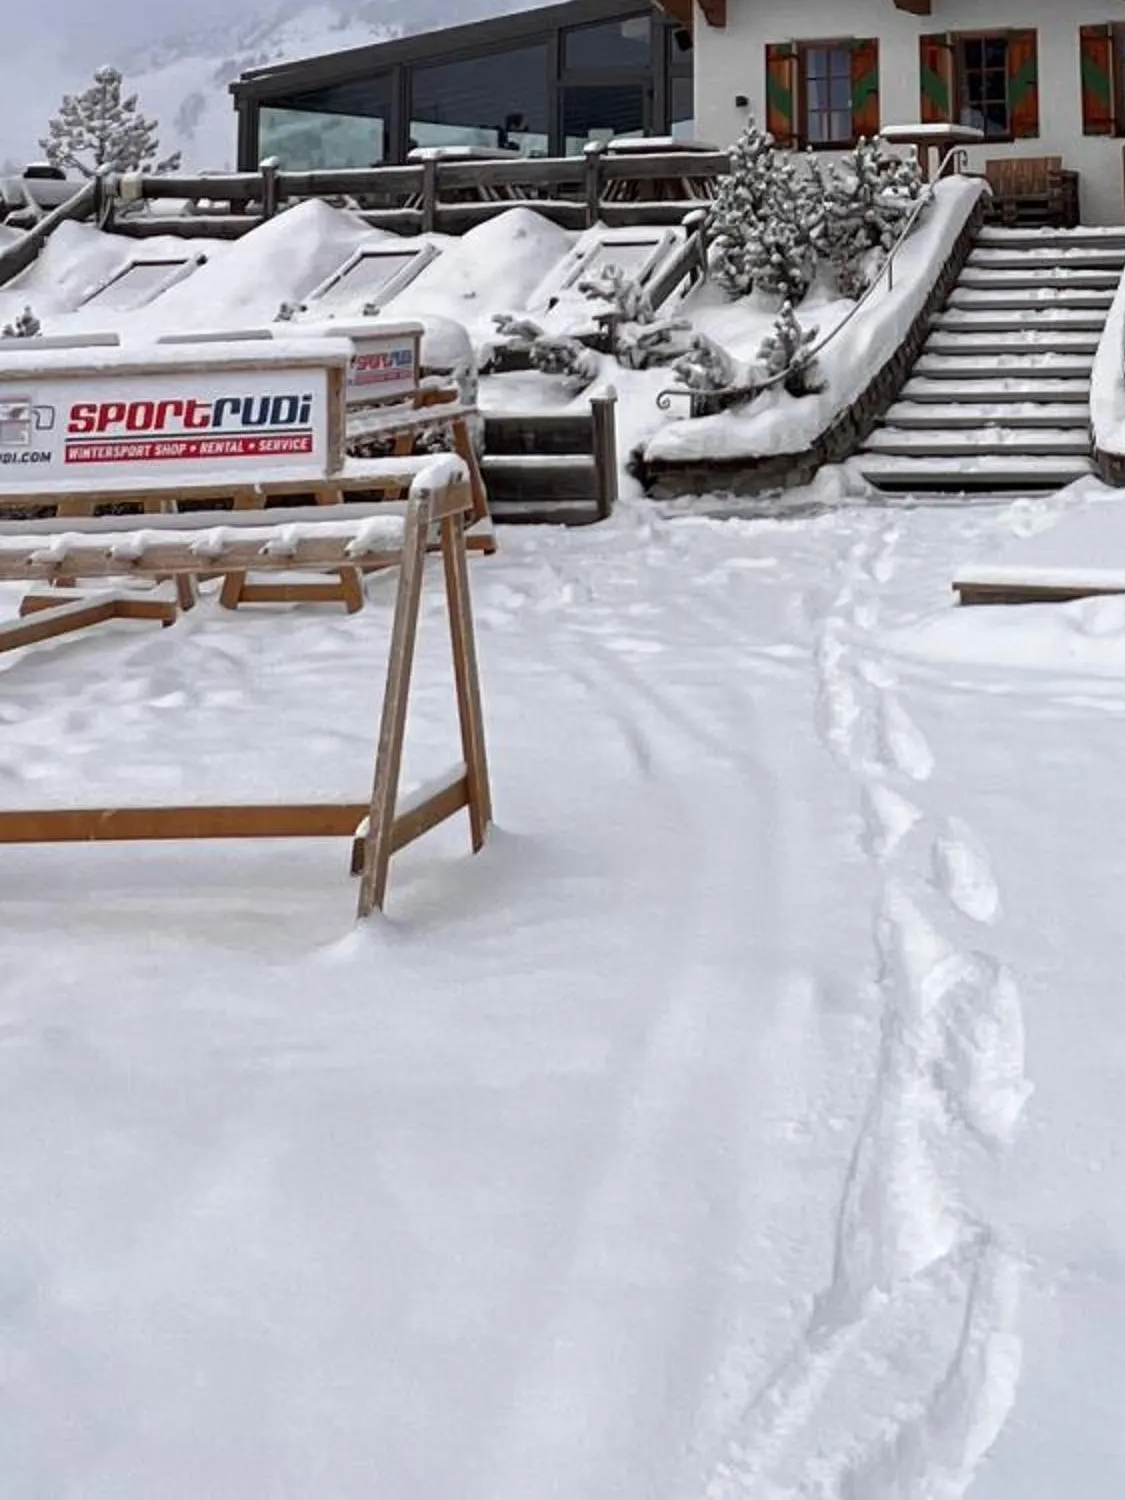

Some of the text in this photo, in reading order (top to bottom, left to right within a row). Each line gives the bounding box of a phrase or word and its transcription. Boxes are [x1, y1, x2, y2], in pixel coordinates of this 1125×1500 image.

[0, 451, 52, 464] DI.COM
[68, 436, 310, 461] WINTERSPORT SHOP RENTAL SERVICE
